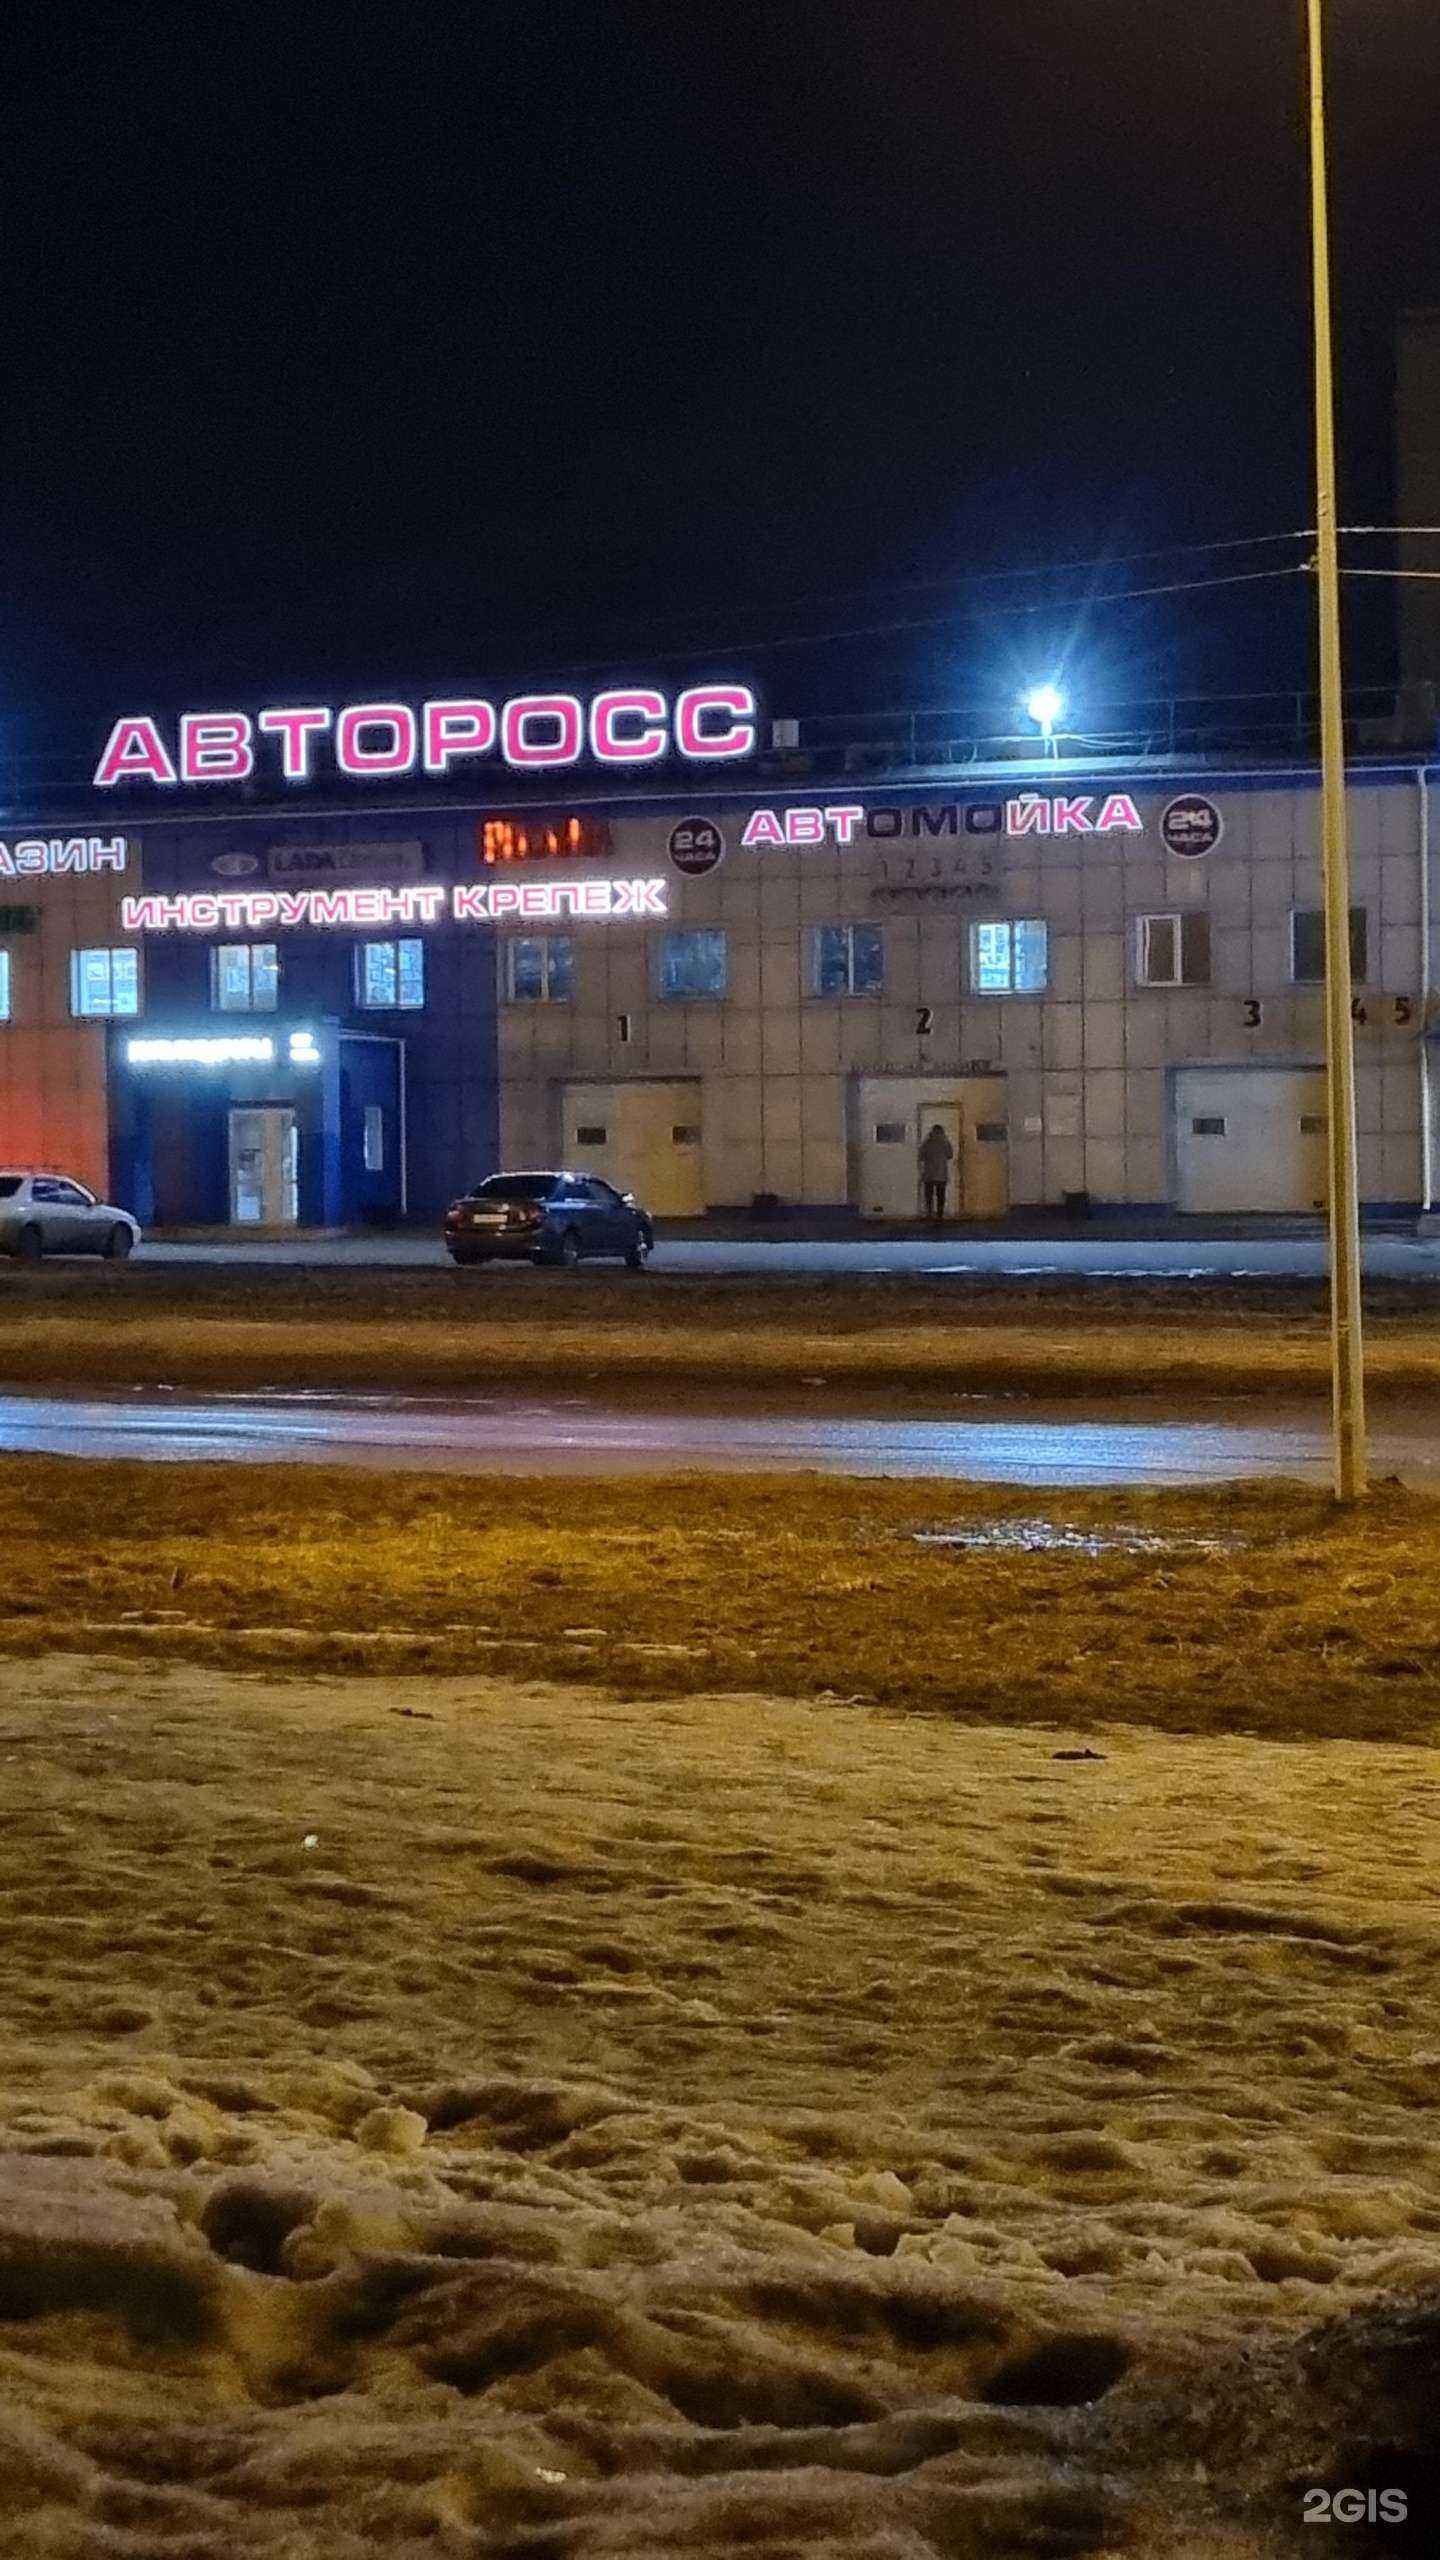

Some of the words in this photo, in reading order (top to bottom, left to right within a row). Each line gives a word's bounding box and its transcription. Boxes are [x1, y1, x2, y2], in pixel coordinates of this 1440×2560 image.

[92, 682, 758, 788] АВТОРОСС
[741, 791, 1144, 846] АВТОМОЙКА
[1168, 809, 1213, 830] 24
[674, 829, 716, 849] 24
[120, 884, 444, 930] ИНСТРУМЕНТ
[453, 878, 669, 919] КРЕПЕЖ
[915, 1007, 934, 1036] 2
[1243, 999, 1263, 1028] 3
[1351, 998, 1368, 1026] 4
[1394, 996, 1411, 1026] 5
[617, 1014, 630, 1042] 1
